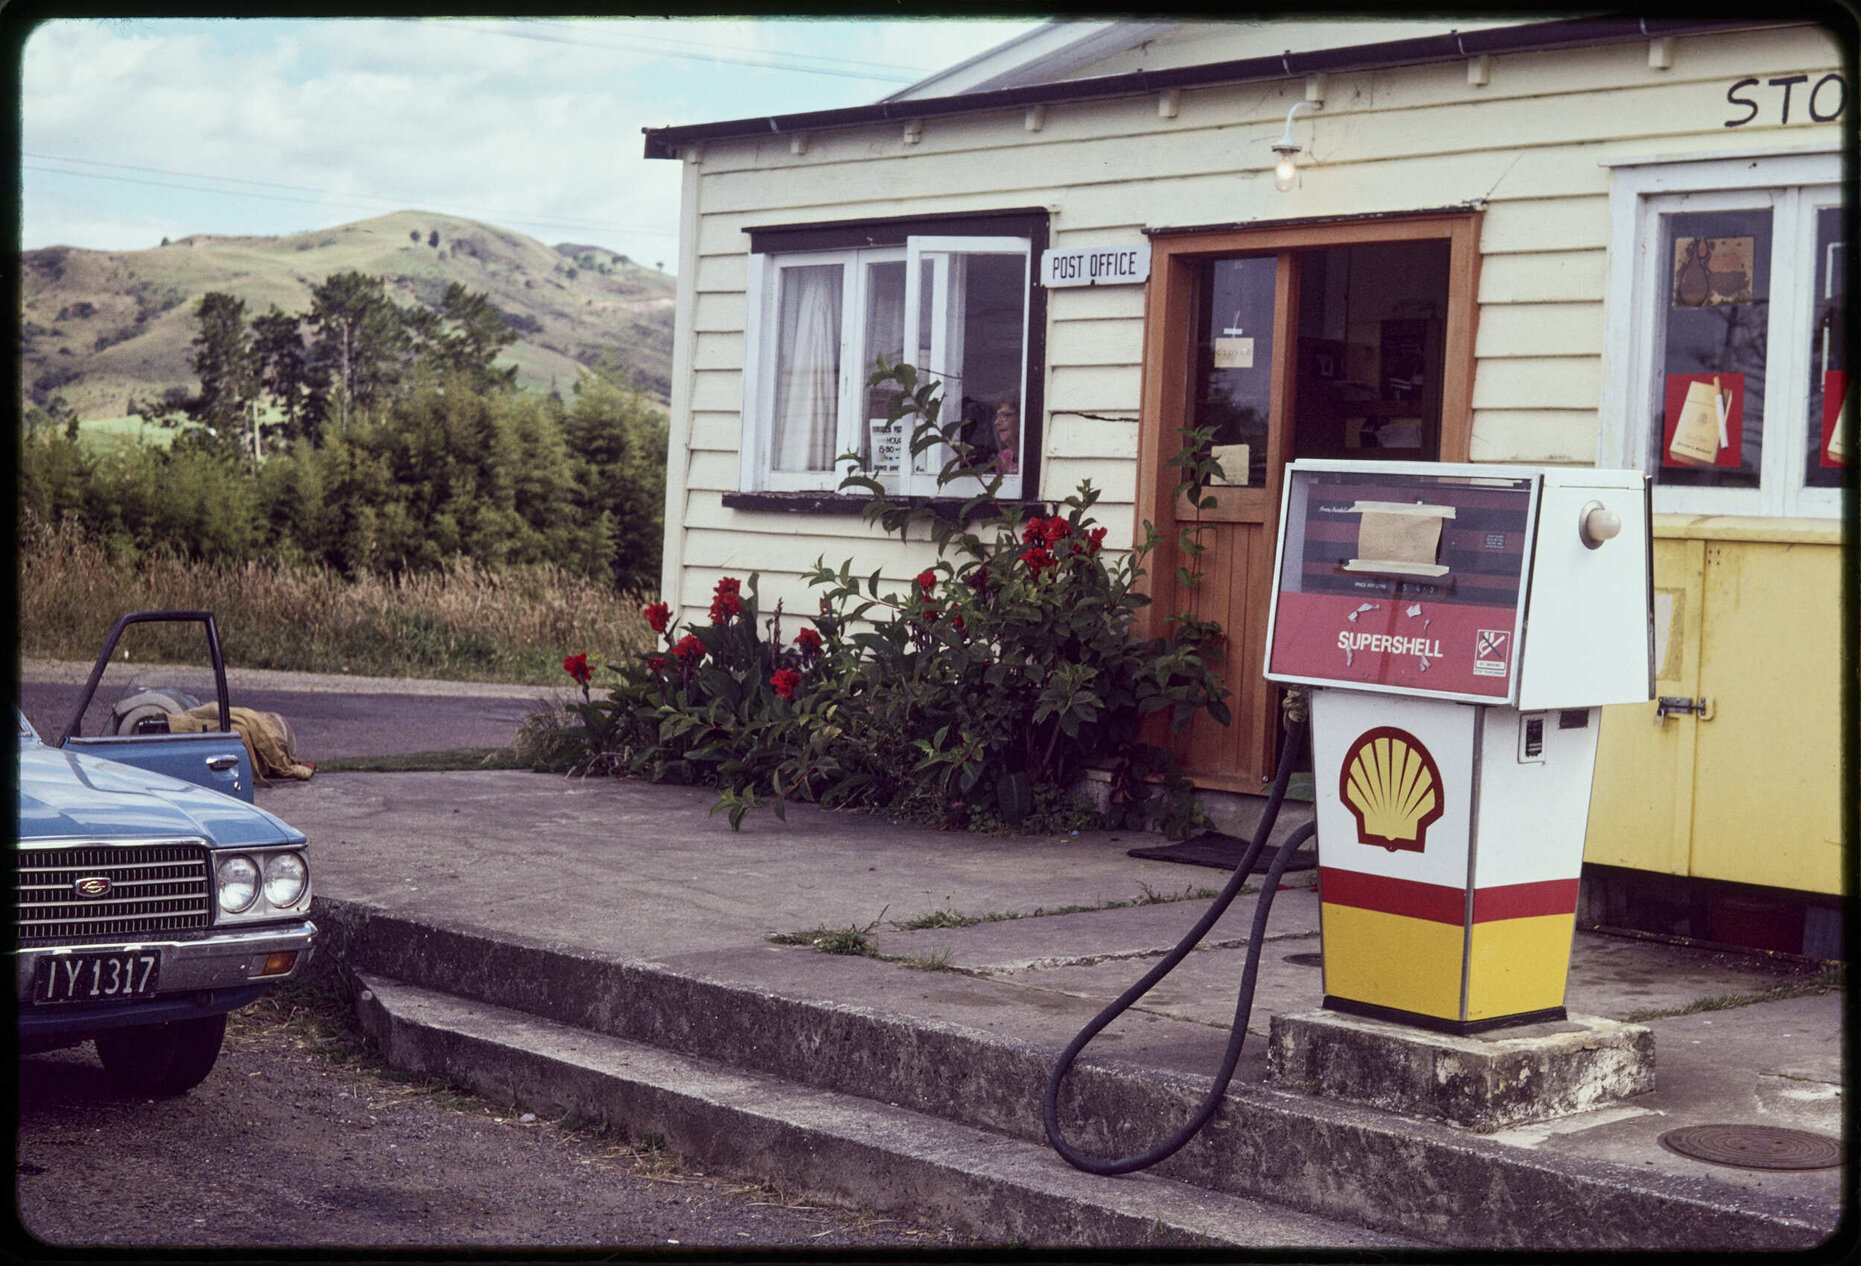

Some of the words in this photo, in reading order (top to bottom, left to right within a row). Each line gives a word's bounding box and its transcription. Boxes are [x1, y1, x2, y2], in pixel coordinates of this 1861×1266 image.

[1724, 74, 1847, 127] STO
[1053, 255, 1084, 279] POST
[1090, 252, 1137, 277] OFFICE
[1337, 631, 1443, 657] SUPERSHELL
[47, 960, 83, 998] IY
[90, 956, 155, 995] 1317
